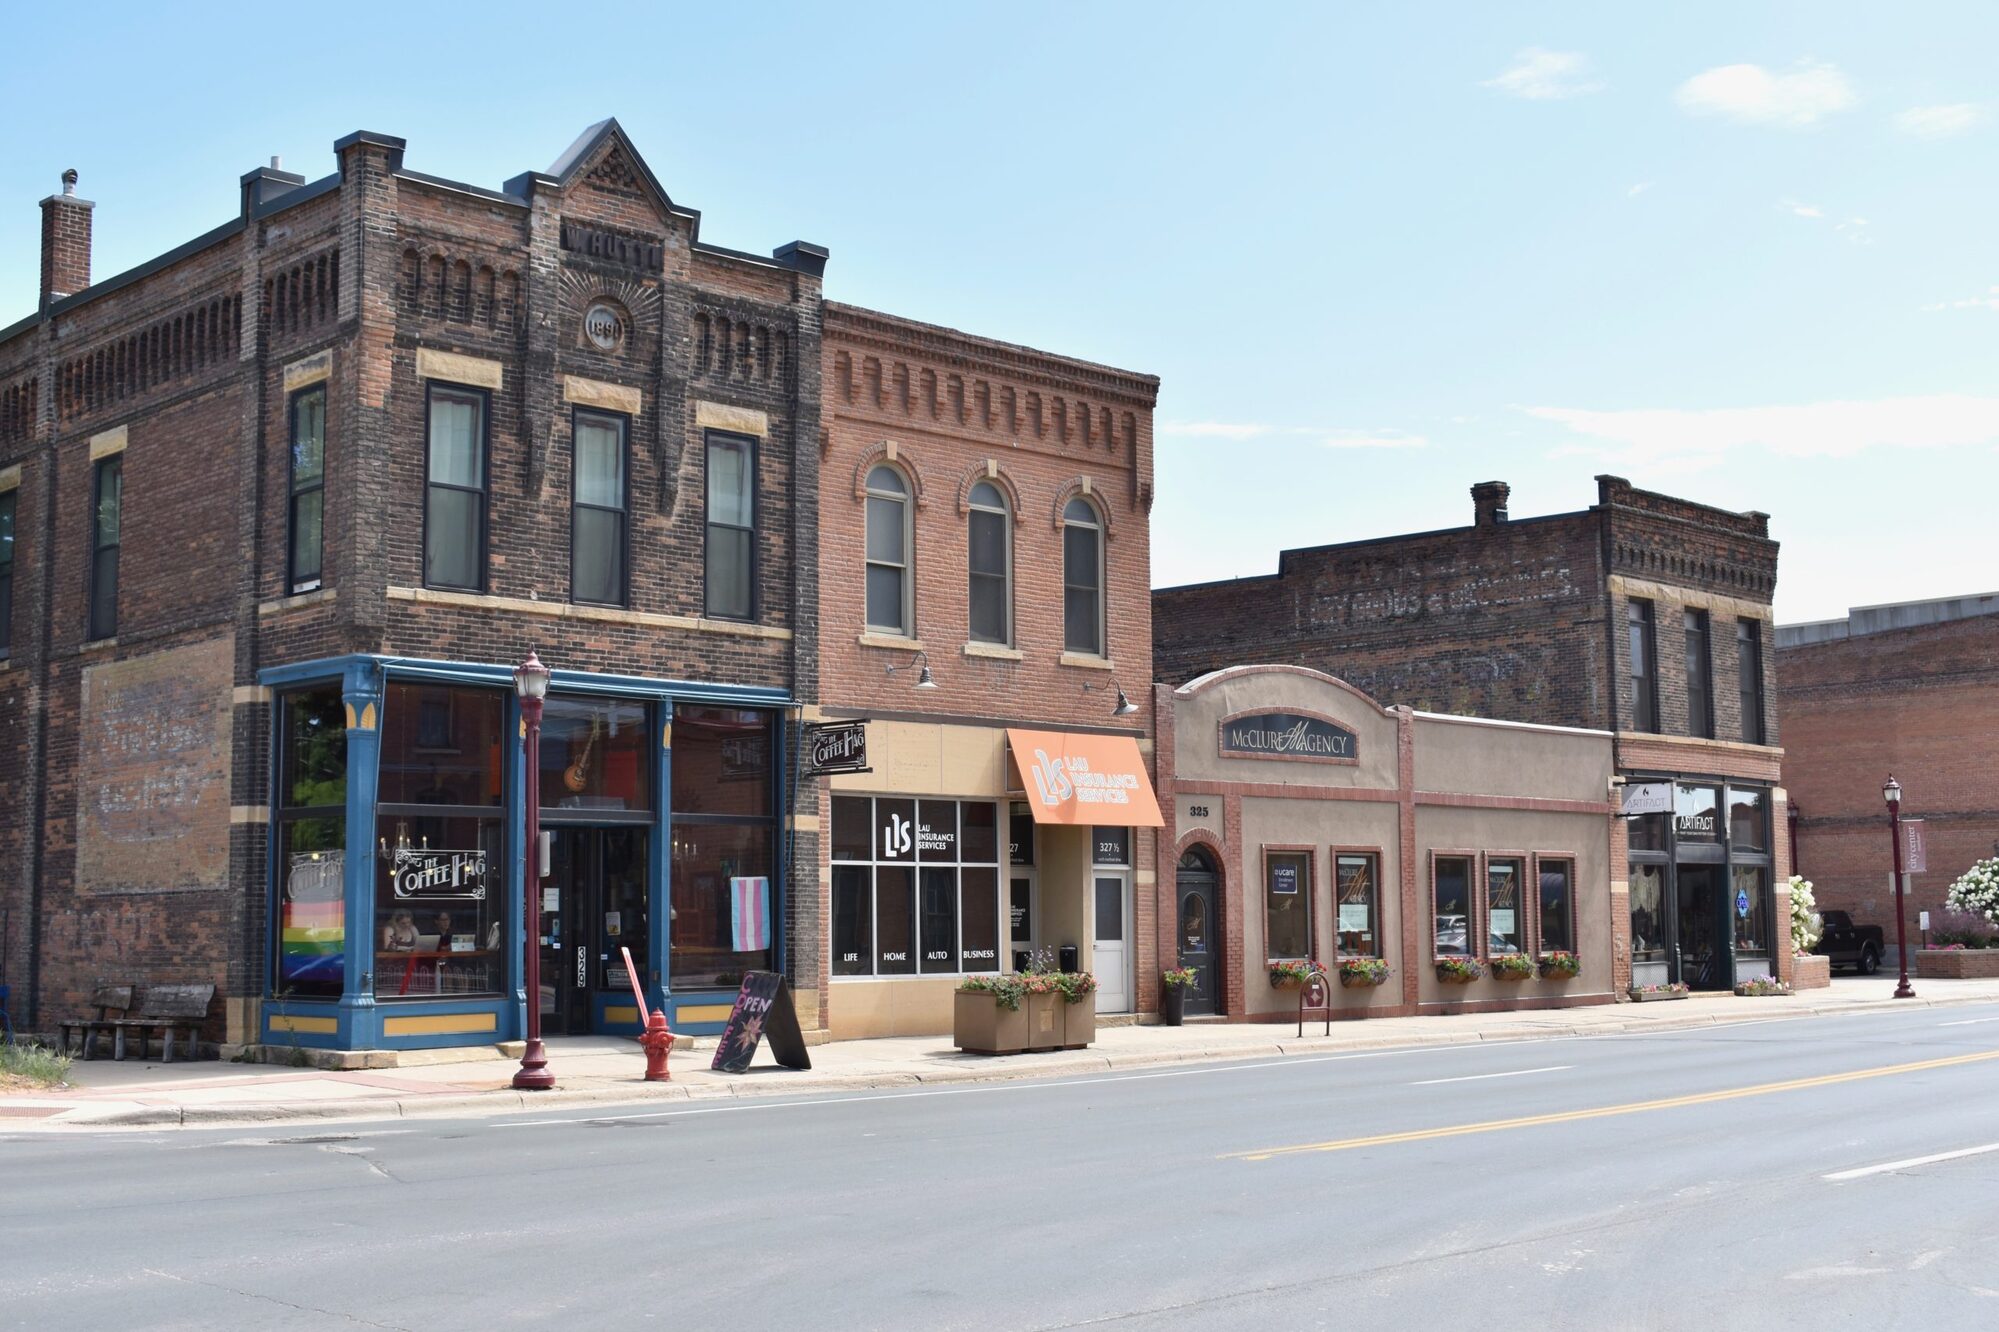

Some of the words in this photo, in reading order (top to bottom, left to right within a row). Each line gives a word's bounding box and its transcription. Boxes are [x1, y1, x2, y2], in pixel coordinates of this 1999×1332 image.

[591, 320, 619, 338] 1891
[813, 739, 844, 766] COFFEE
[844, 730, 864, 757] HAG
[1232, 728, 1283, 748] McCLURE
[1301, 734, 1347, 754] AGENCY
[1064, 755, 1088, 771] LAU
[1069, 771, 1139, 788] INSURANCE
[1075, 787, 1129, 804] SERVICES
[1627, 797, 1665, 809] ARTIFACT
[1190, 806, 1208, 817] 325
[918, 824, 930, 832] LAU
[1680, 816, 1713, 830] ARTIFACT
[918, 833, 954, 841] INSURANCE
[918, 841, 946, 850] SERVICES
[1100, 842, 1112, 852] 327
[425, 857, 438, 869] THE
[394, 864, 451, 897] COFFEE
[452, 853, 485, 888] HAG
[844, 953, 858, 961] LIFE
[883, 952, 906, 961] HOME
[927, 951, 947, 959] AUTO
[963, 950, 994, 959] BUSINESS
[578, 947, 586, 987] 329
